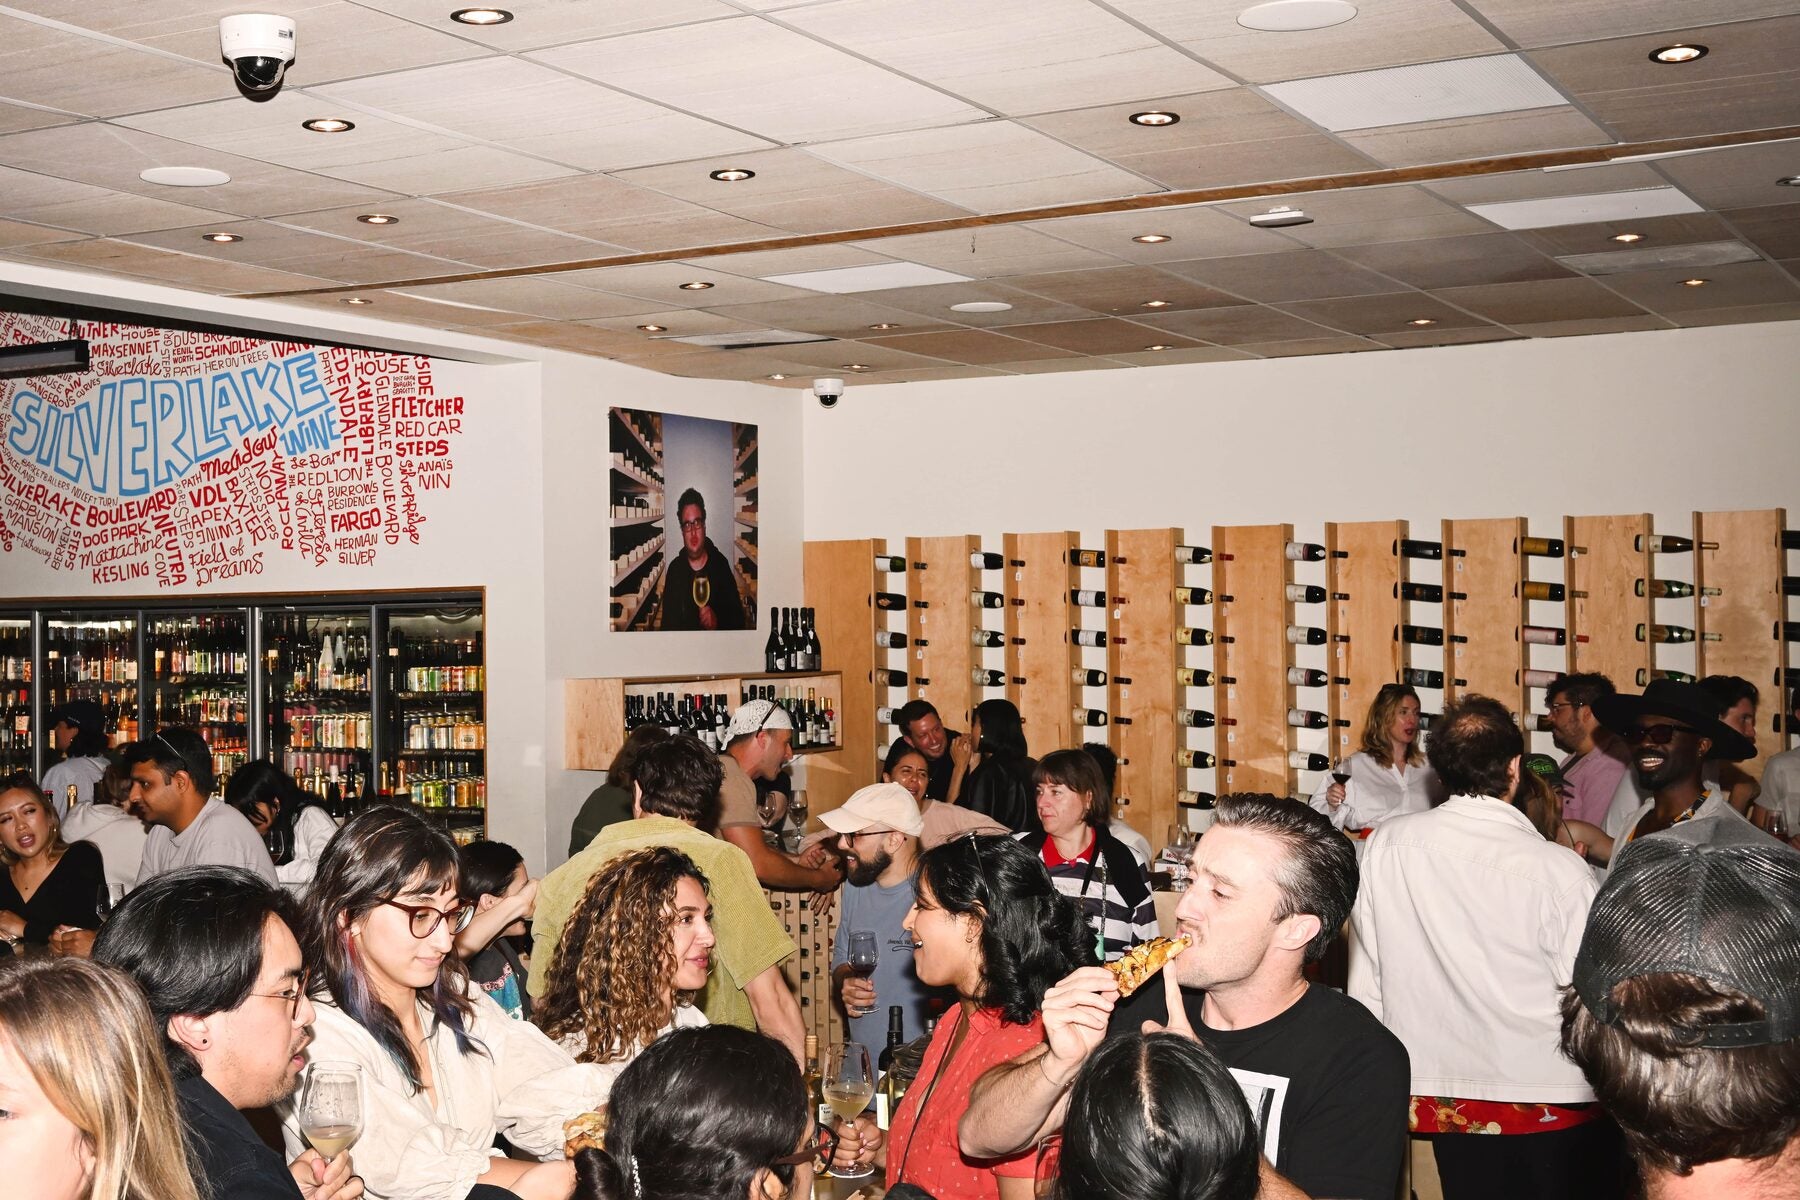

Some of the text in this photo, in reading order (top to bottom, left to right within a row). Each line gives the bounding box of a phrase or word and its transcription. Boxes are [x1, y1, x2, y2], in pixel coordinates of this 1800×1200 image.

[60, 320, 120, 341] LAUTNER
[121, 328, 161, 341] HOUSE
[161, 348, 171, 379] STEPS
[172, 354, 194, 364] WORTH
[173, 364, 201, 376] PATH
[240, 350, 269, 365] TREES
[195, 337, 258, 361] SCHINDLER
[96, 354, 162, 377] Silverlake
[319, 351, 335, 386] PATH
[354, 357, 410, 377] HOUSE
[25, 378, 101, 408] DANGEROUS CURVES
[330, 346, 359, 463] EDENDALE
[391, 396, 465, 419] FLETCHER
[8, 352, 331, 497] SILVERLAKE
[279, 405, 343, 456] WINE
[356, 376, 377, 478] THE LIBRARY
[395, 418, 463, 438] RED CAR
[200, 425, 278, 482] Meadow
[309, 449, 342, 469] Bar
[375, 375, 400, 546] GLENDALE BOULEVARD
[395, 439, 449, 458] STEPS
[2, 447, 36, 483] SPACELAND
[0, 462, 178, 529] SILVERLAKE BOULEVARD
[181, 471, 203, 490] PATH
[188, 483, 227, 508] VDL
[239, 466, 263, 504] STEPS
[288, 474, 296, 489] THE
[327, 480, 379, 499] BURROWS
[418, 472, 451, 490] NIN
[4, 493, 63, 529] GARBUTT
[98, 496, 119, 508] TURN
[225, 476, 267, 546] BAXTER
[269, 449, 294, 550] ROCKAWAY
[327, 494, 377, 511] RESIDENCE
[5, 509, 60, 545] MANSION
[174, 506, 194, 549] STEPS
[191, 504, 234, 530] APEX
[256, 503, 279, 540] STEPS
[330, 507, 382, 533] FARGO
[50, 521, 73, 571] BERKELY
[65, 530, 82, 571] STEPS
[82, 520, 151, 549] DOG PARK
[151, 513, 187, 586] NEUTRA
[334, 533, 378, 550] HERMAN
[79, 534, 164, 570] Mattachine
[188, 537, 245, 569] Field of
[92, 560, 150, 585] KESLING
[154, 552, 172, 588] COVE
[196, 552, 264, 587] Dreams
